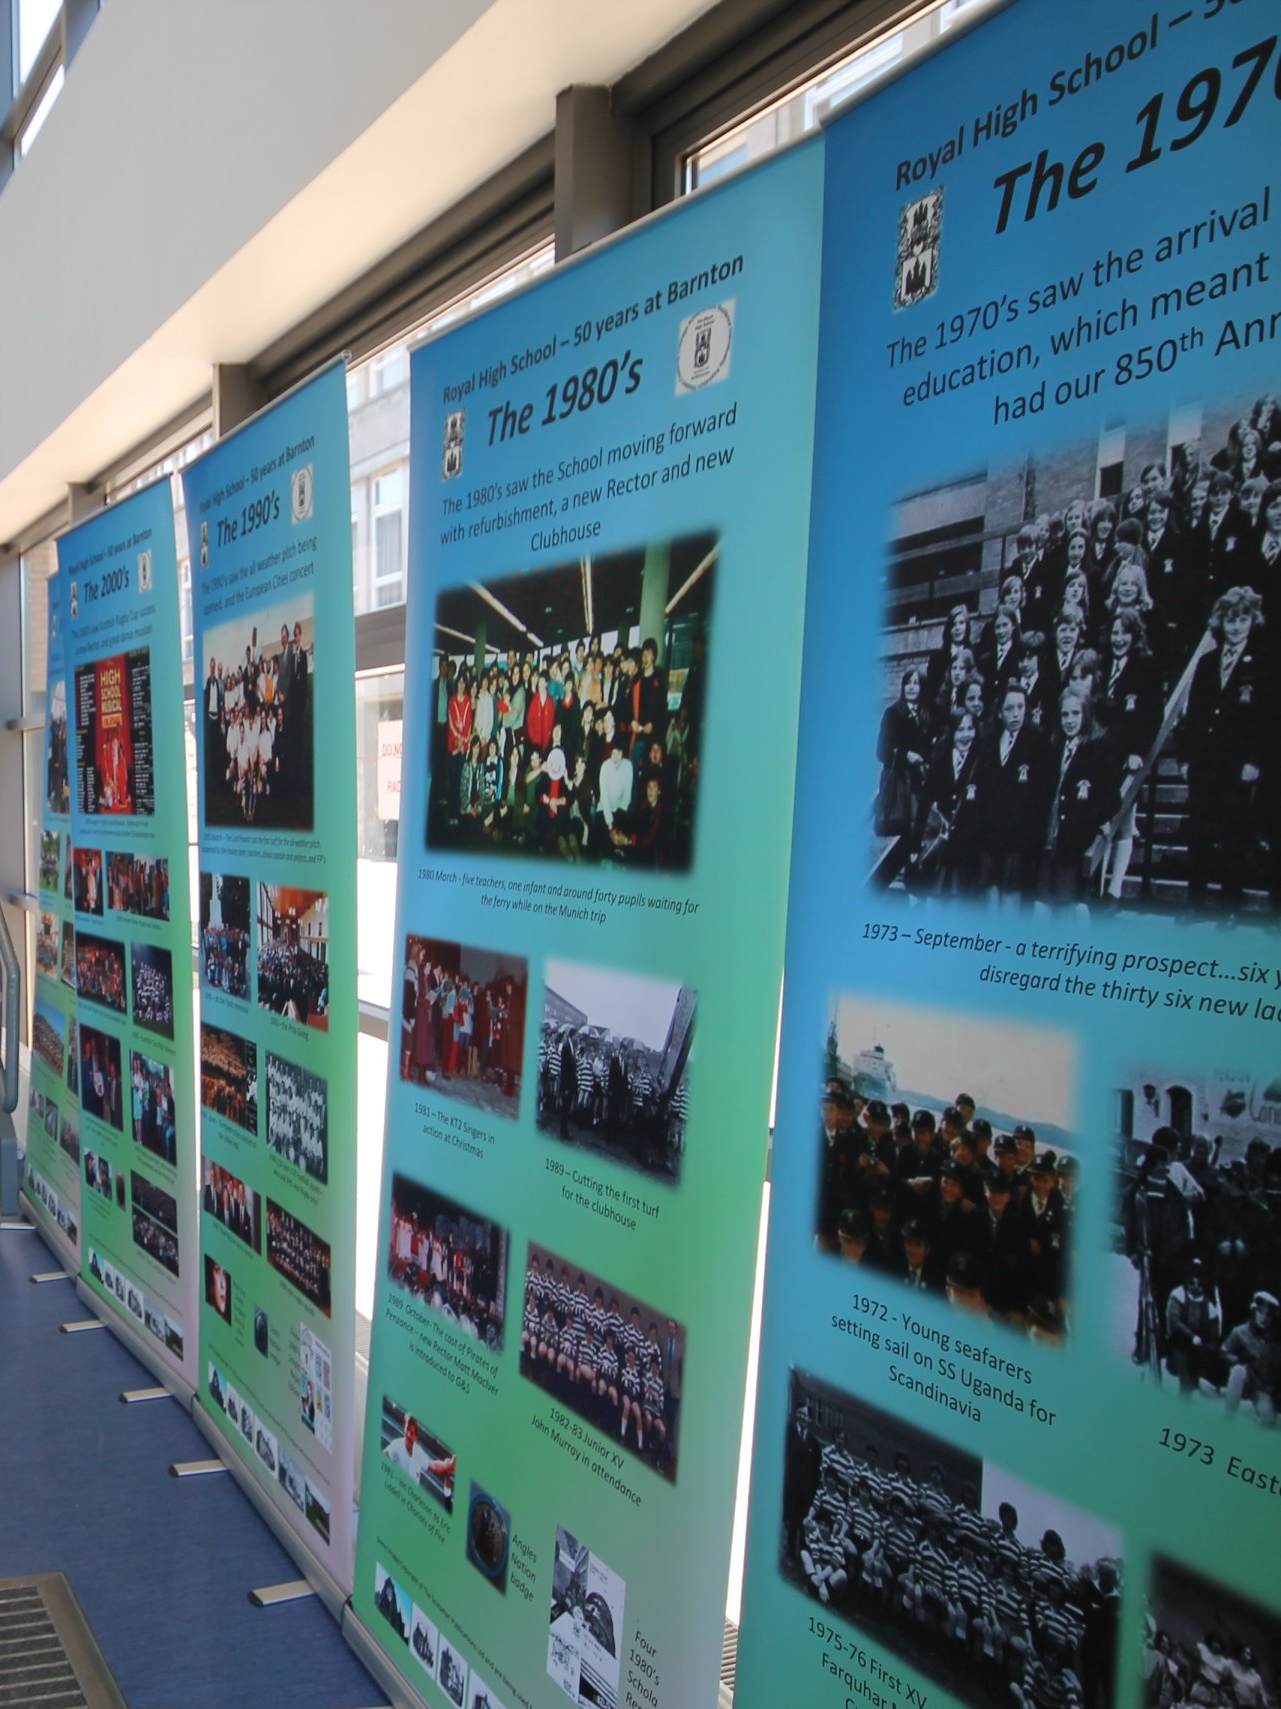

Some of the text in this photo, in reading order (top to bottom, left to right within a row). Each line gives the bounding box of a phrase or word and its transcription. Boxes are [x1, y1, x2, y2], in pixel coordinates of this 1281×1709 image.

[897, 14, 1158, 191] Royal High School
[993, 35, 1281, 235] The 197
[887, 186, 1270, 369] The 1970's saw the arrival
[443, 254, 744, 404] Royal High School 50 years at Barnton
[903, 252, 1270, 406] education, which meant
[487, 350, 643, 446] The 1980's
[994, 381, 1045, 424] had
[1055, 368, 1106, 405] our
[1114, 326, 1204, 385] 850th
[441, 401, 738, 516] The 1980's saw the School moving forward
[217, 490, 280, 548] The 1990's
[440, 448, 735, 545] with refurbishment, a new Rector and new
[530, 520, 601, 551] Clubhouse
[84, 564, 129, 604] The 2000's
[418, 868, 699, 915] 1980 March five teachers, one infant and around forty pupils waiting for
[481, 894, 606, 924] the ferry while on the Munich trip
[862, 923, 899, 942] 1973
[914, 928, 1002, 953] September
[1016, 942, 1026, 956] a
[1030, 941, 1118, 971] terrifying
[979, 965, 1061, 992] disregard
[1065, 975, 1096, 997] the
[1102, 979, 1160, 1008] thirty
[1164, 989, 1193, 1010] six
[1198, 994, 1249, 1017] new
[414, 1102, 430, 1118] 1981
[437, 1111, 449, 1125] The
[463, 1120, 486, 1142] Singers
[488, 1132, 495, 1144] in
[422, 1124, 484, 1159] action at Christmas
[545, 1158, 660, 1219] 1989 Cutting the first turf
[562, 1185, 636, 1230] for the clubhouse
[852, 1294, 1034, 1386] 1972 Young seafarers
[831, 1314, 1057, 1427] setting sail on SS Uganda for
[889, 1364, 982, 1423] Scandinavia
[532, 1415, 642, 1506] John Murray in attendance
[550, 1407, 625, 1470] 1982-83 Junior XV
[1158, 1427, 1281, 1498] 1973 East
[511, 1552, 536, 1583] Nation
[512, 1534, 537, 1563] Angles
[510, 1572, 534, 1602] badge
[629, 1649, 660, 1685] 1980's
[635, 1631, 657, 1657] Four
[809, 1617, 927, 1709] 1975-76 First XV
[627, 1671, 658, 1706] Schola
[822, 1653, 887, 1706] Farquhar
